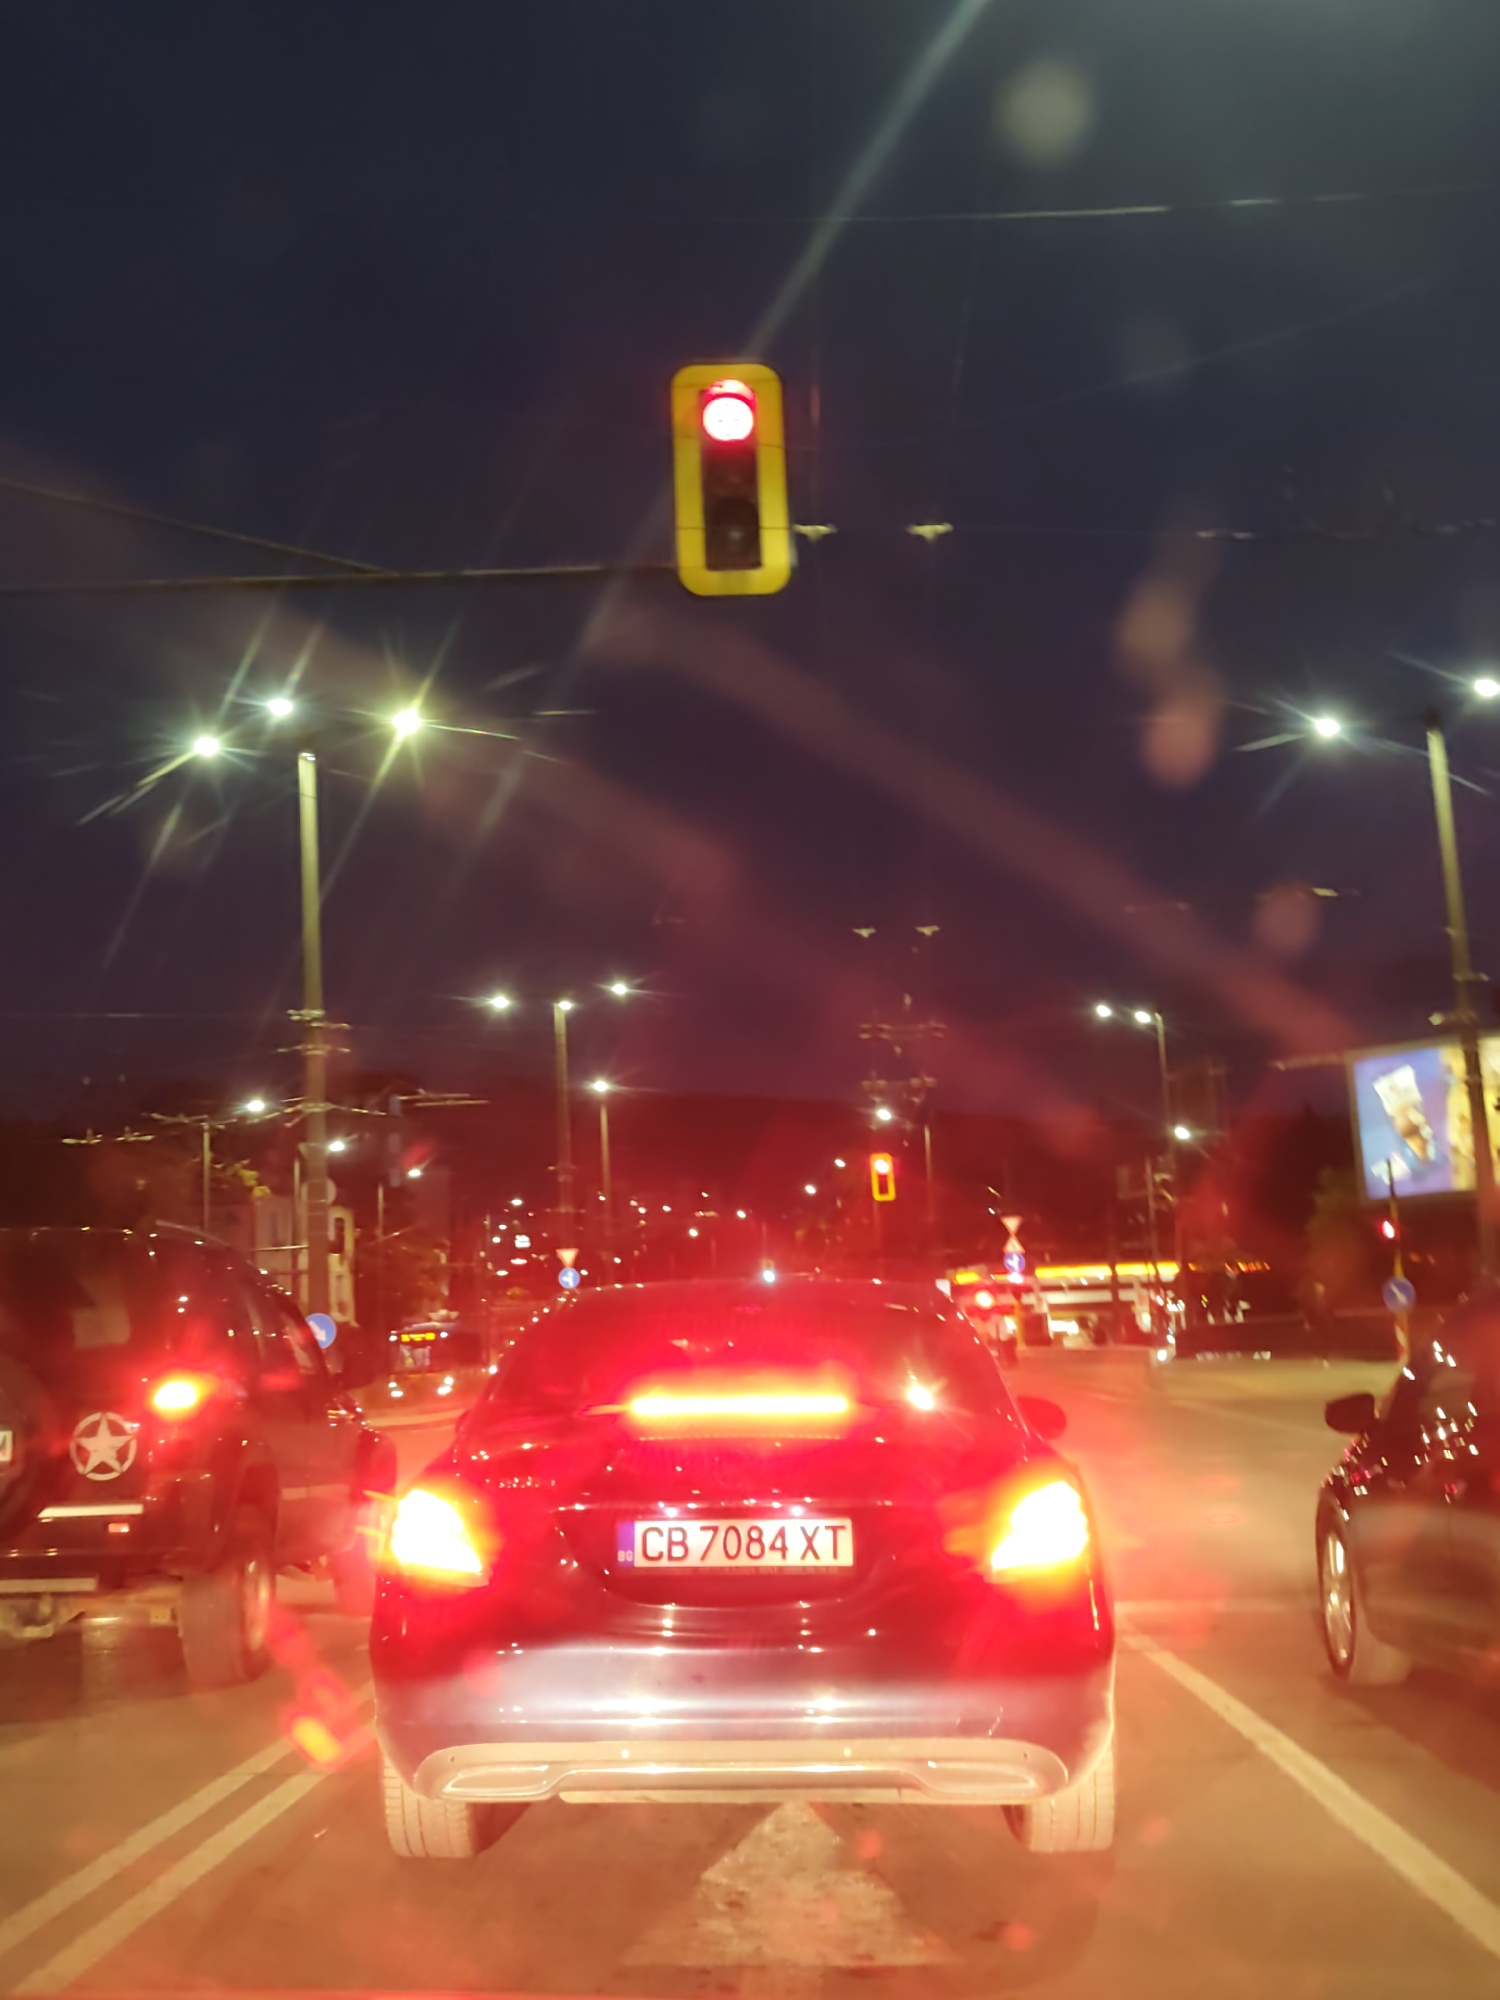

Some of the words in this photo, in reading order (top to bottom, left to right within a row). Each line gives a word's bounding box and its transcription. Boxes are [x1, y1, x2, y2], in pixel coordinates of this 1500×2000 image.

[641, 1526, 689, 1562] CB
[699, 1525, 789, 1561] 7084
[800, 1525, 846, 1561] XT
